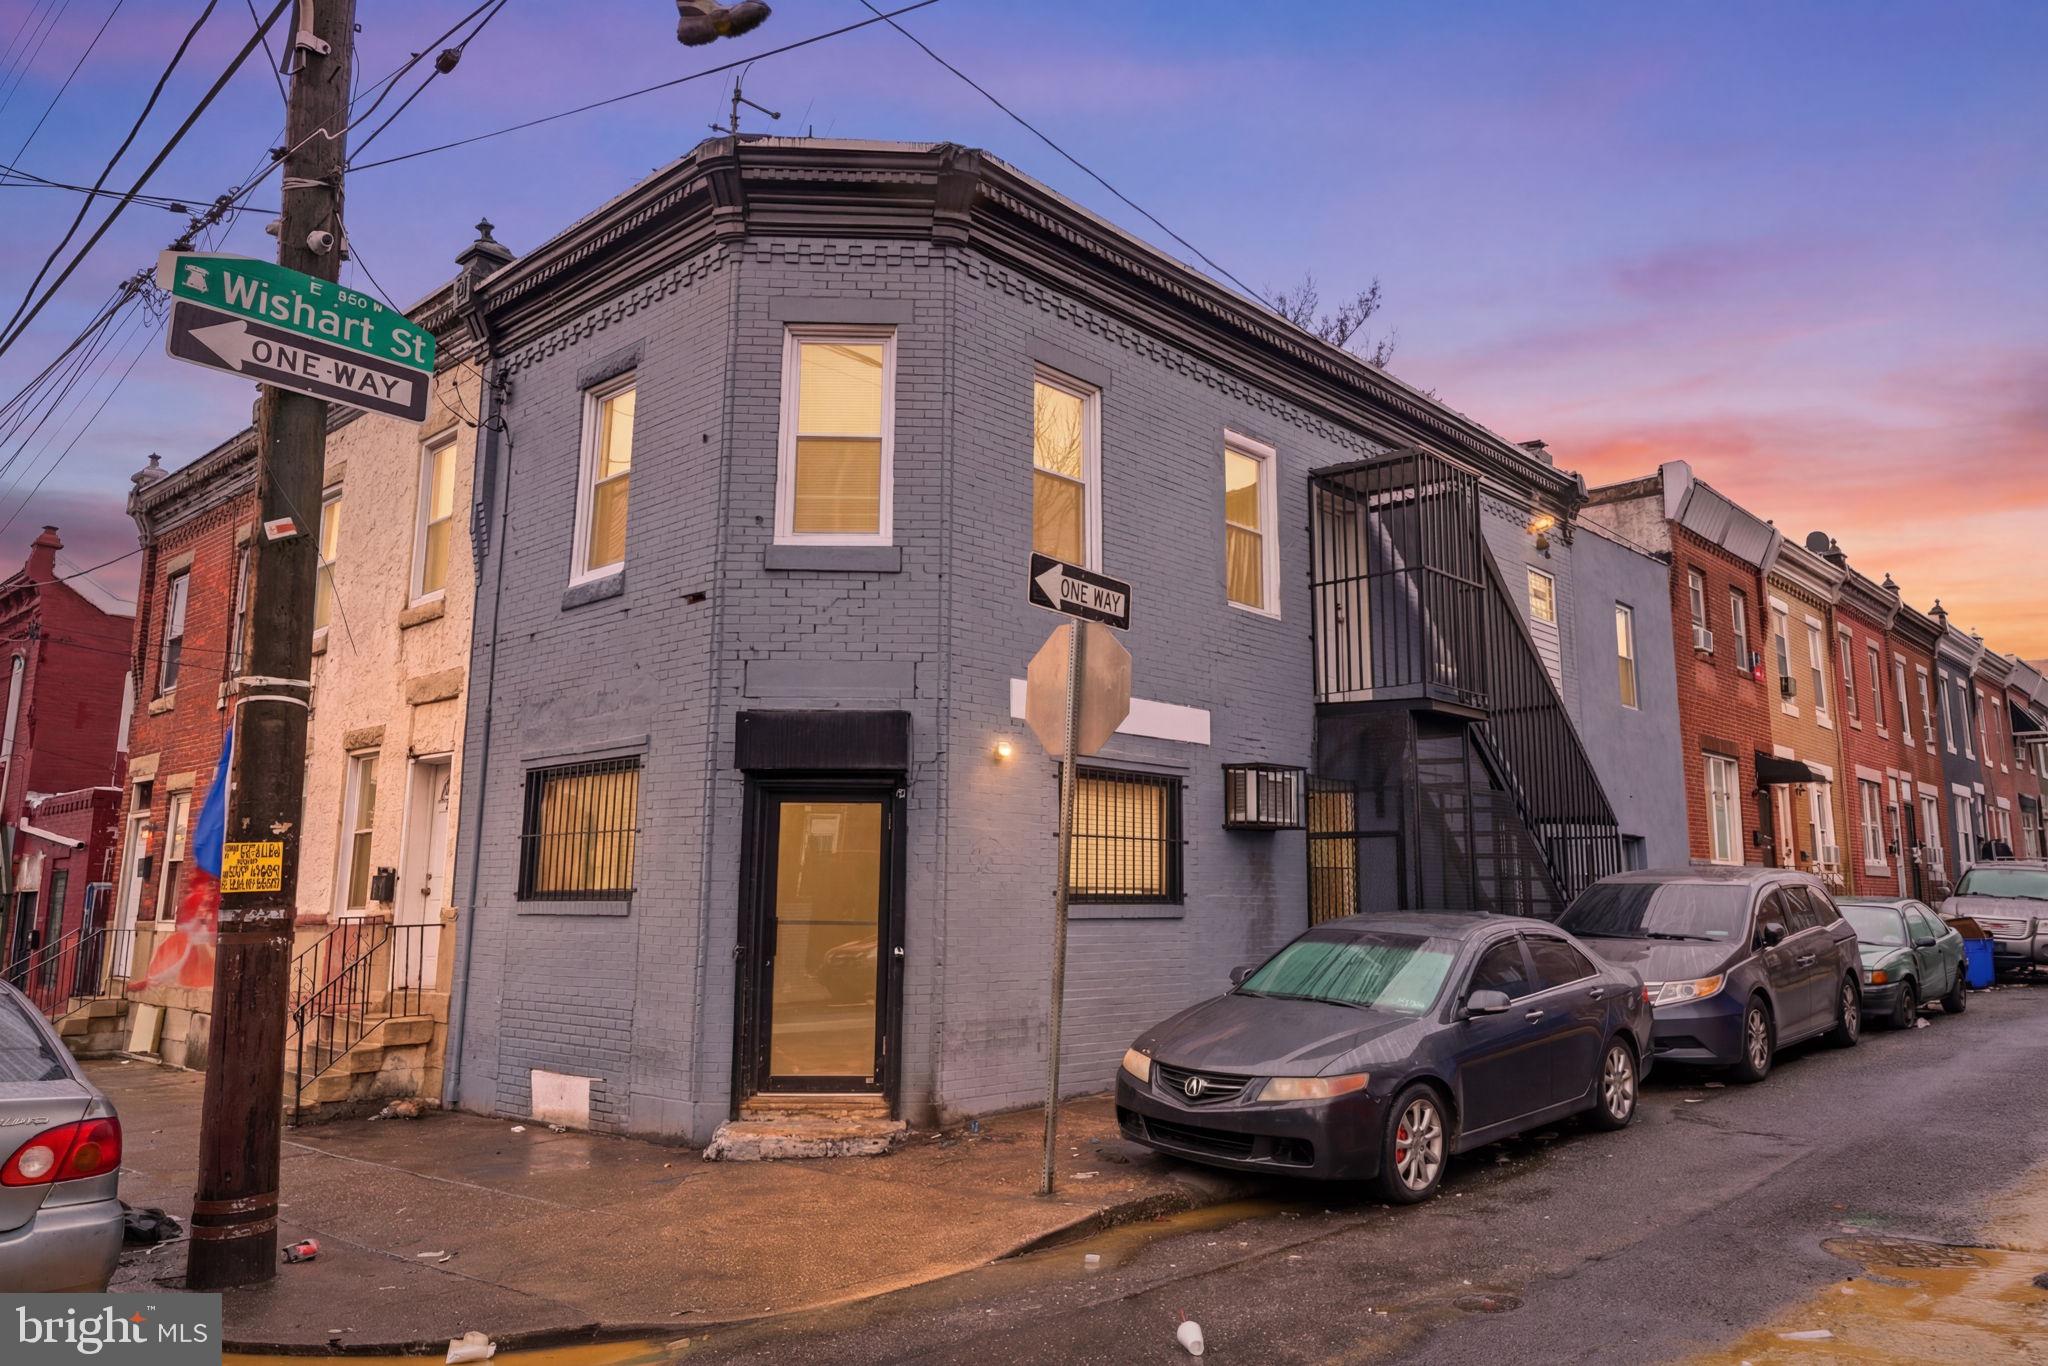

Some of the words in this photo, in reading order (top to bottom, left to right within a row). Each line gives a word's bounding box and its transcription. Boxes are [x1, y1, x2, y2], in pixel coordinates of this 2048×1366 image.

[310, 281, 323, 296] E
[373, 302, 383, 313] W
[223, 271, 375, 348] Wishart
[390, 327, 426, 364] St
[1061, 578, 1088, 604] ONE
[1094, 588, 1120, 612] WAY
